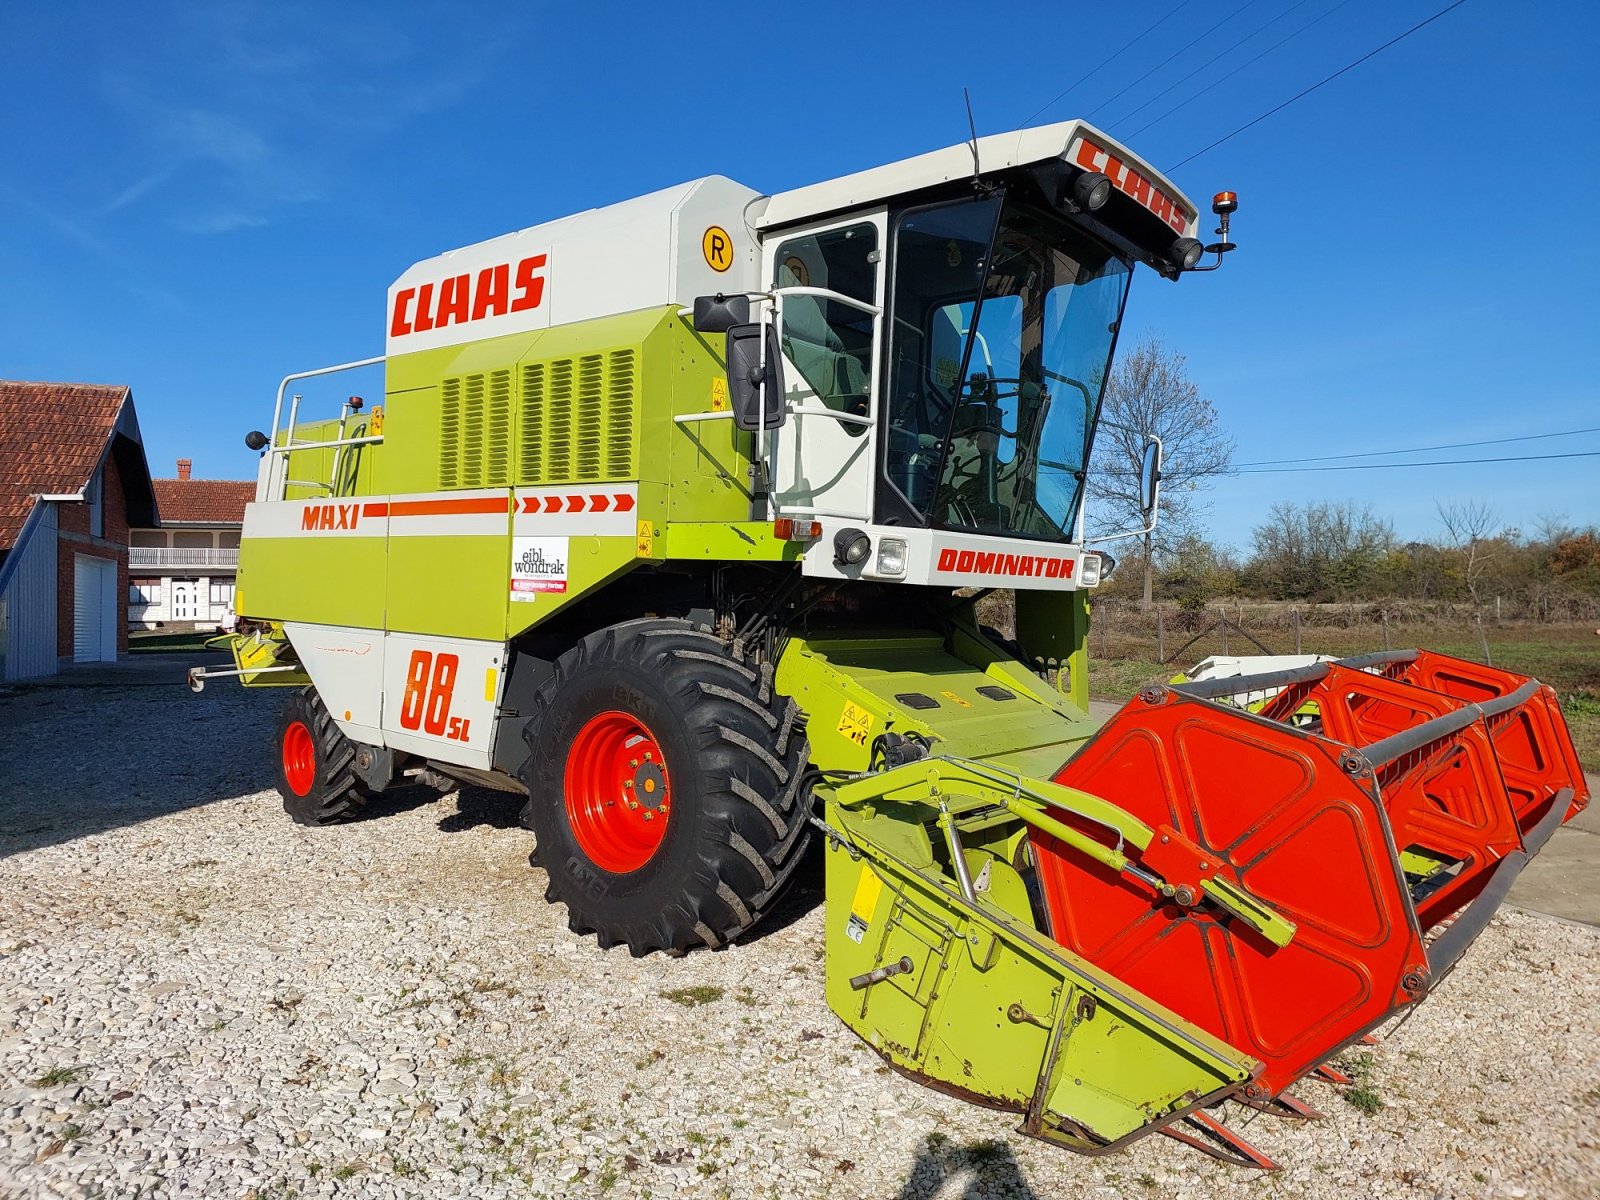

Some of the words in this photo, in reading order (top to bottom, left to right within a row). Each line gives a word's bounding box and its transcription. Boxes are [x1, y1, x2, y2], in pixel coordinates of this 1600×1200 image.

[1077, 138, 1187, 235] CLAAS
[711, 235, 725, 262] R
[390, 253, 548, 338] CLAAS
[301, 503, 360, 531] MAXI
[514, 559, 565, 575] wondrak
[522, 548, 543, 563] eibl
[937, 548, 1075, 579] DOMINATOR
